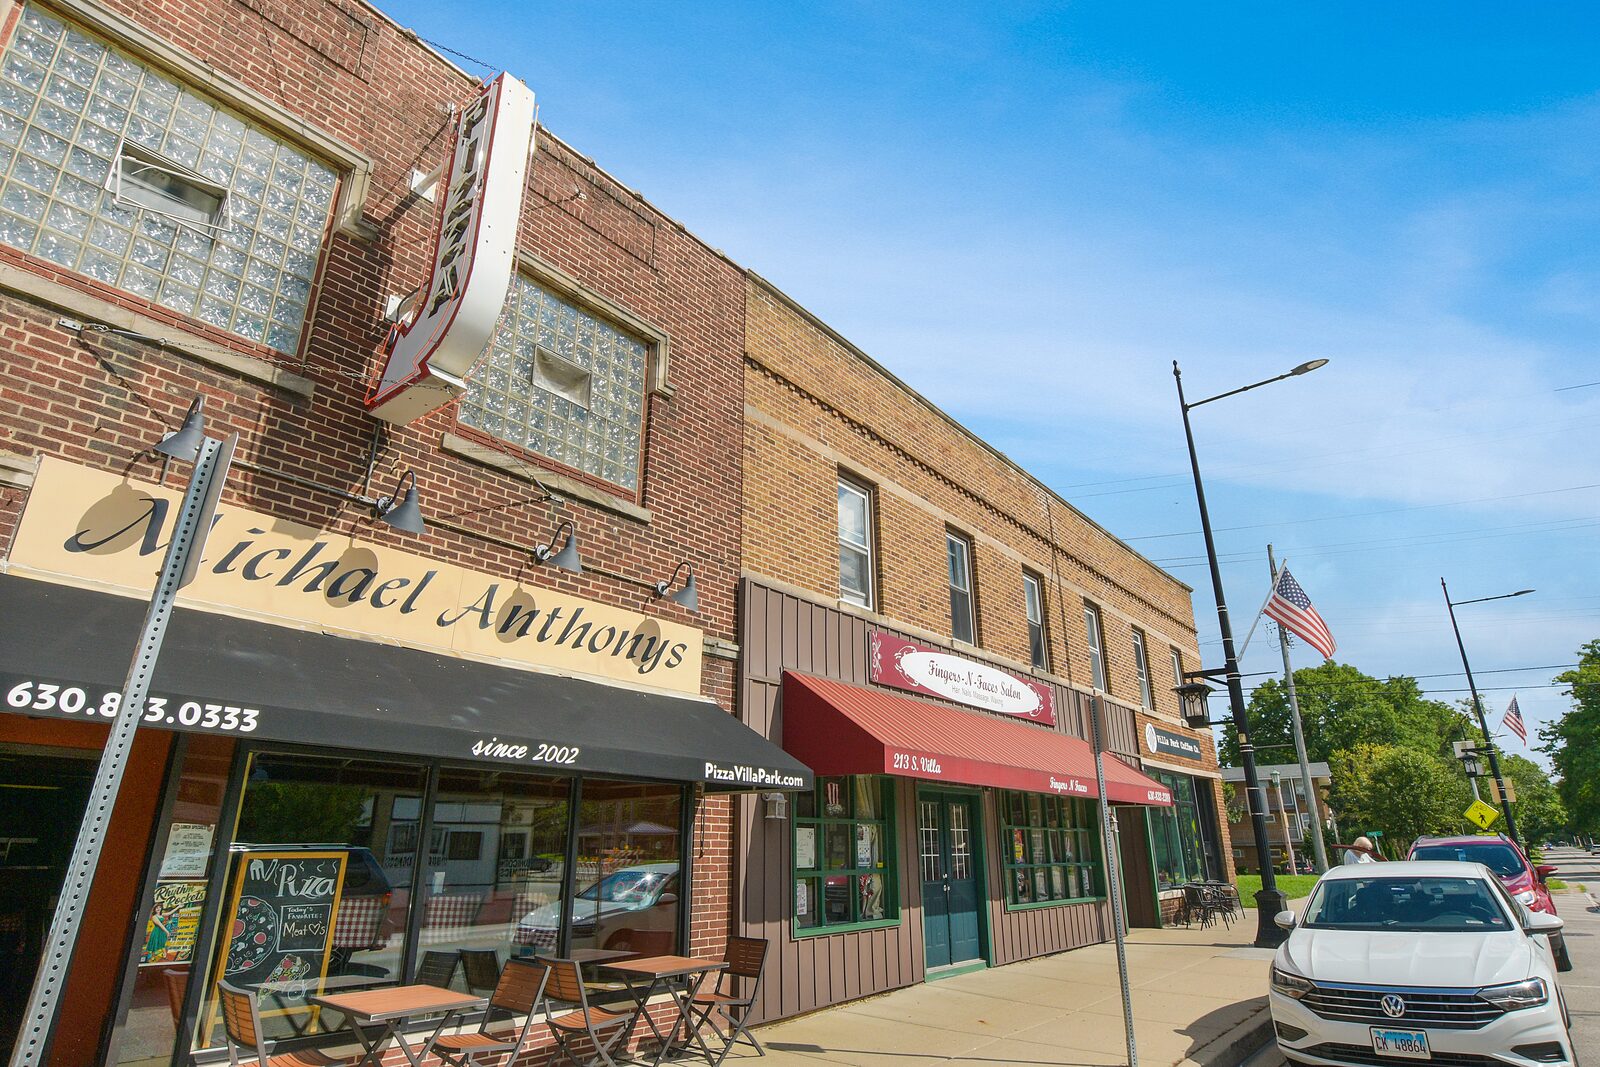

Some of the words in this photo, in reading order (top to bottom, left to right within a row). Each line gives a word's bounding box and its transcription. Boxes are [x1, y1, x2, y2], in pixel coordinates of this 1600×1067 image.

[436, 583, 688, 675] Anthonys
[1000, 681, 1021, 700] Salon
[6, 681, 260, 732] 630.83.0333
[1156, 735, 1169, 746] Villa
[471, 737, 528, 759] since
[532, 743, 579, 764] 2002
[893, 752, 910, 769] 213
[911, 755, 919, 771] S.
[920, 756, 942, 774] Villa
[704, 762, 804, 787] PizzaVillaPark.com
[1049, 776, 1068, 793] Fingers
[1069, 779, 1075, 791] N
[1074, 780, 1088, 793] Faces
[155, 885, 194, 901] Rhythm
[282, 921, 308, 938] Meat
[1375, 1036, 1389, 1050] CK
[1394, 1038, 1426, 1053] 48864
